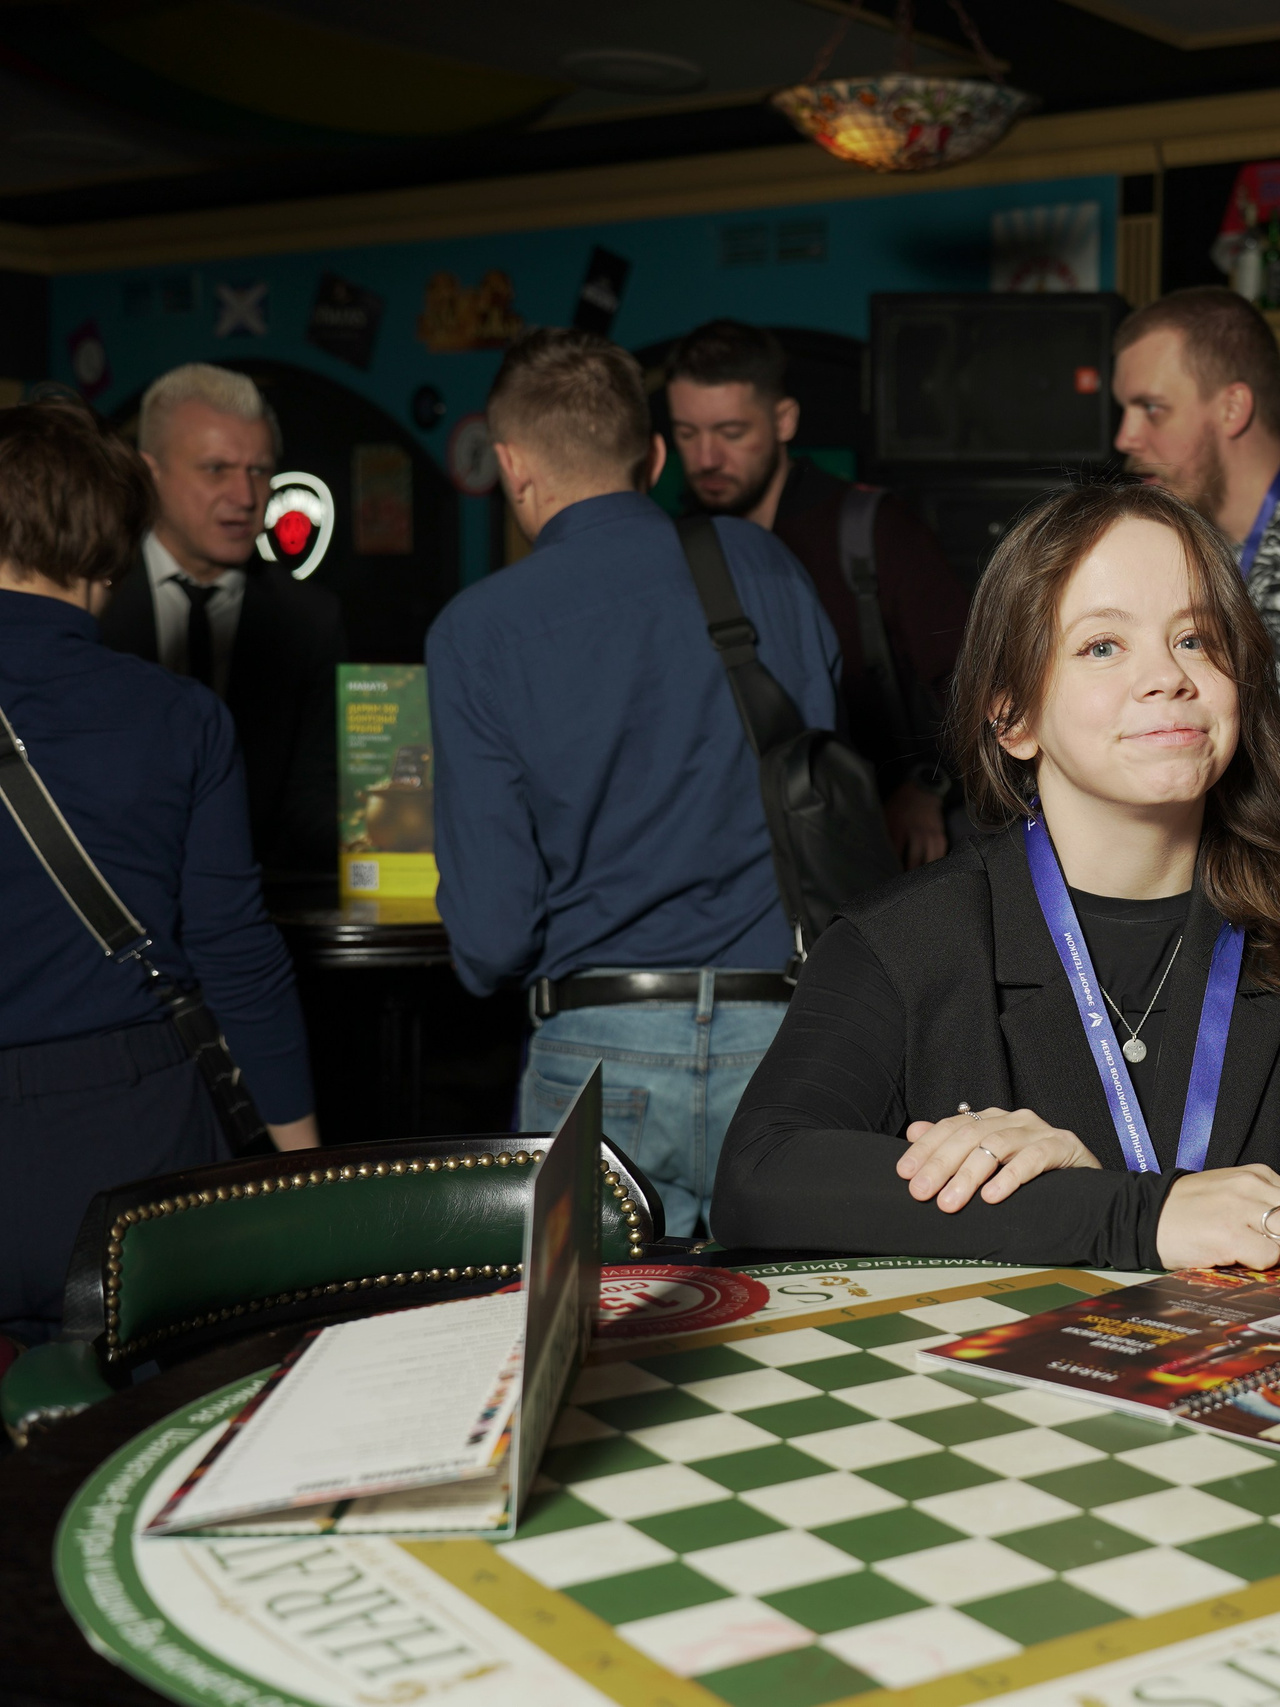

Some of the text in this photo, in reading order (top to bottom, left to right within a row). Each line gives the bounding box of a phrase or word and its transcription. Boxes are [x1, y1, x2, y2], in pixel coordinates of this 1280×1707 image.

[1063, 932, 1095, 1007] ЭФФОРТ ТЕЛЕКОМ
[1100, 1039, 1114, 1066] СВЯЗИ
[1110, 1067, 1133, 1122] ОПЕРАТОРОВ
[600, 1281, 650, 1294] СТО
[205, 1538, 473, 1680] HARAT
